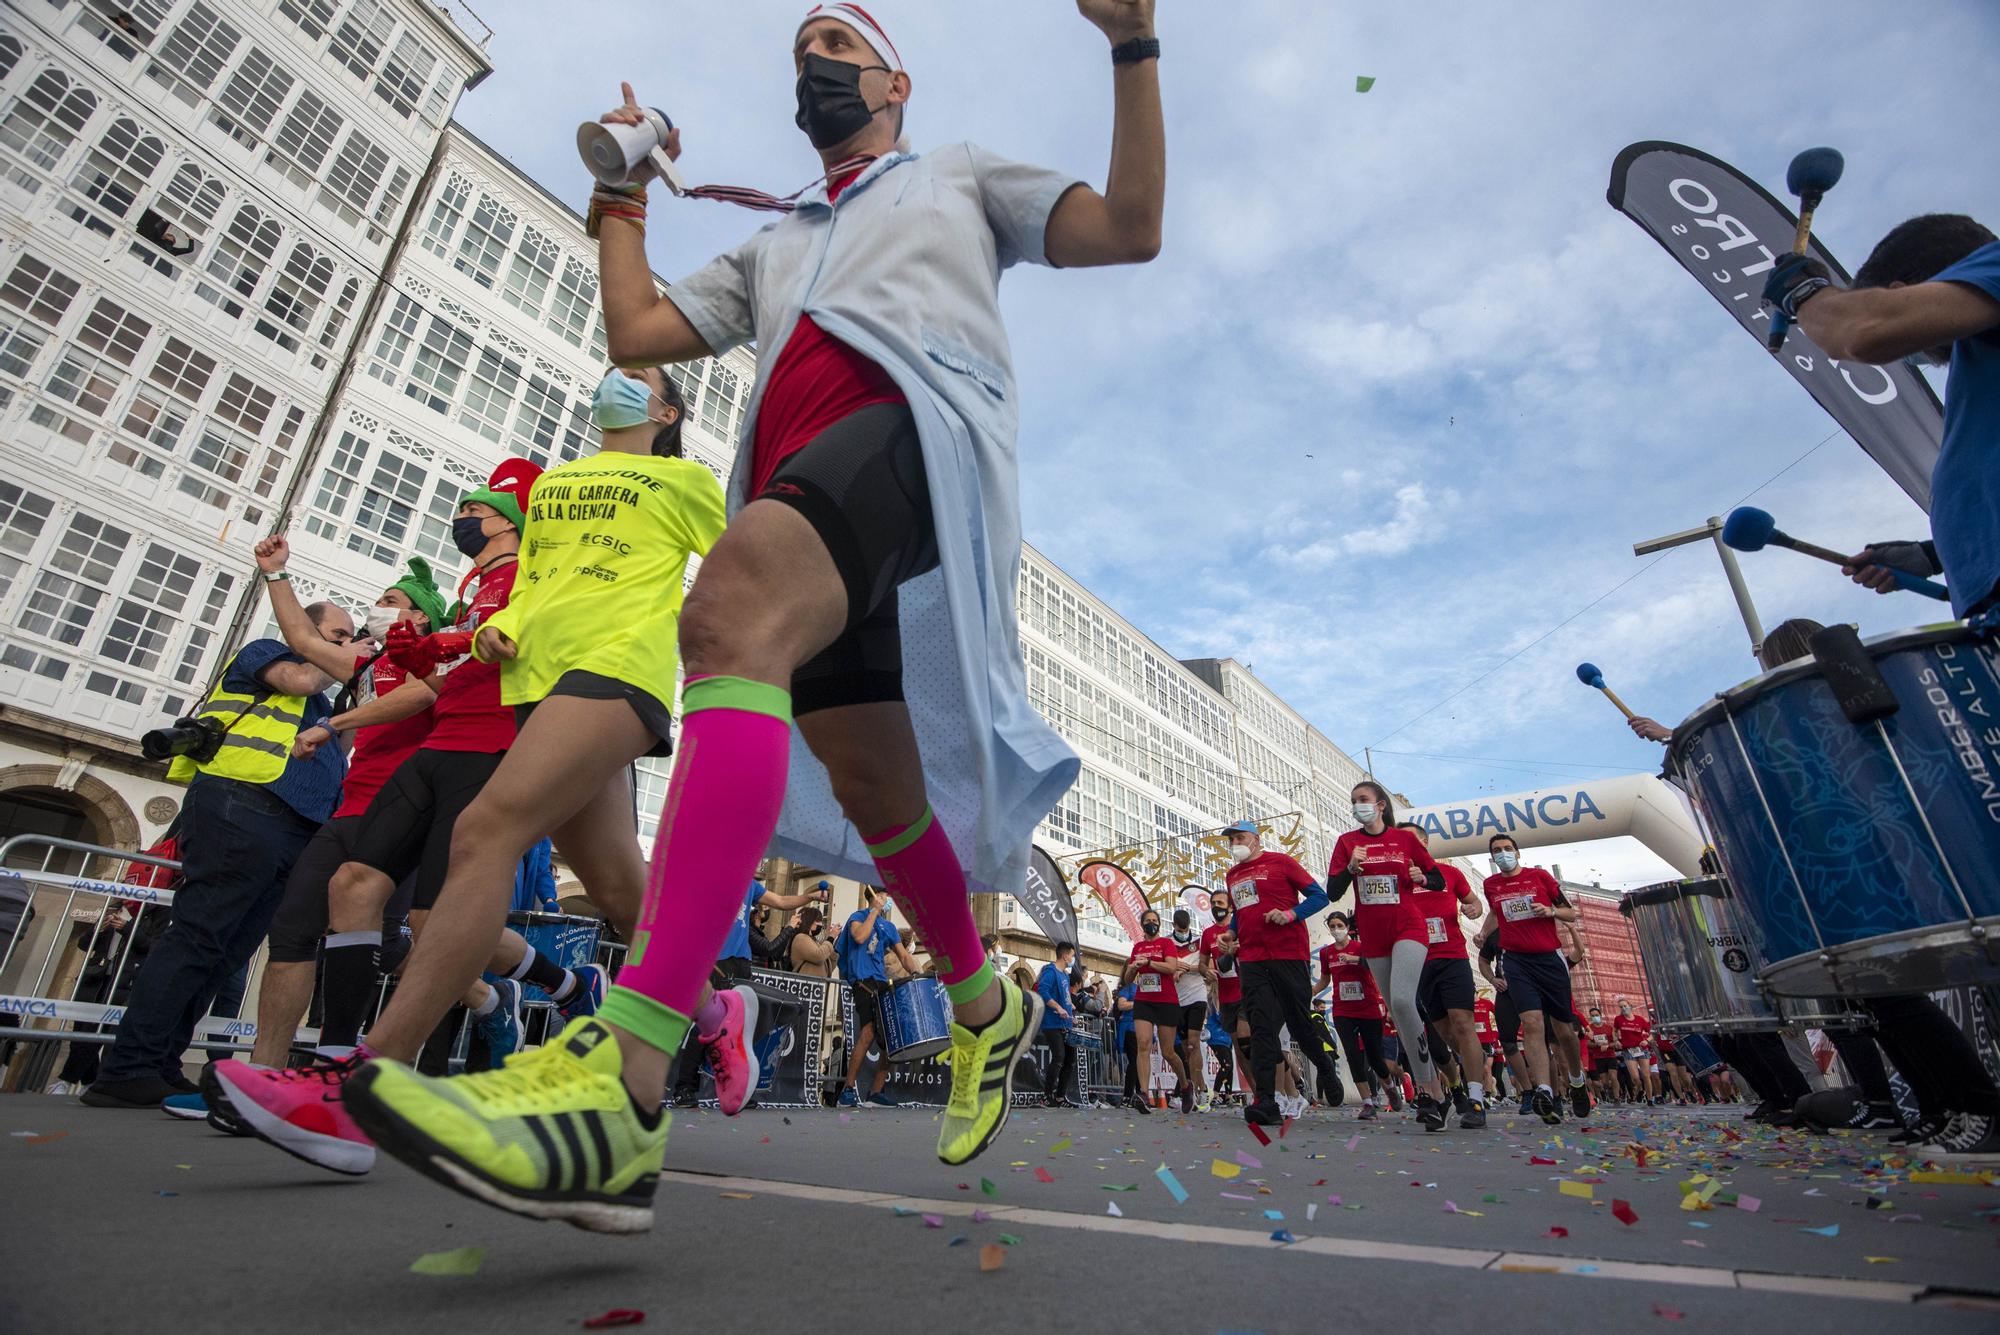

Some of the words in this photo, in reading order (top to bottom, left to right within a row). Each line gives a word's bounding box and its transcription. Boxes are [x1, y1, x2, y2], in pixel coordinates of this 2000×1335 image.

[579, 485, 639, 507] CARRERA
[532, 504, 545, 522] DE
[548, 503, 563, 520] LA
[569, 503, 616, 520] CIENCIA
[592, 535, 631, 555] CSIC
[1420, 790, 1606, 840] ABANCA
[79, 880, 158, 902] ABANCA
[1366, 882, 1390, 894] 3755
[1510, 902, 1528, 913] 1358
